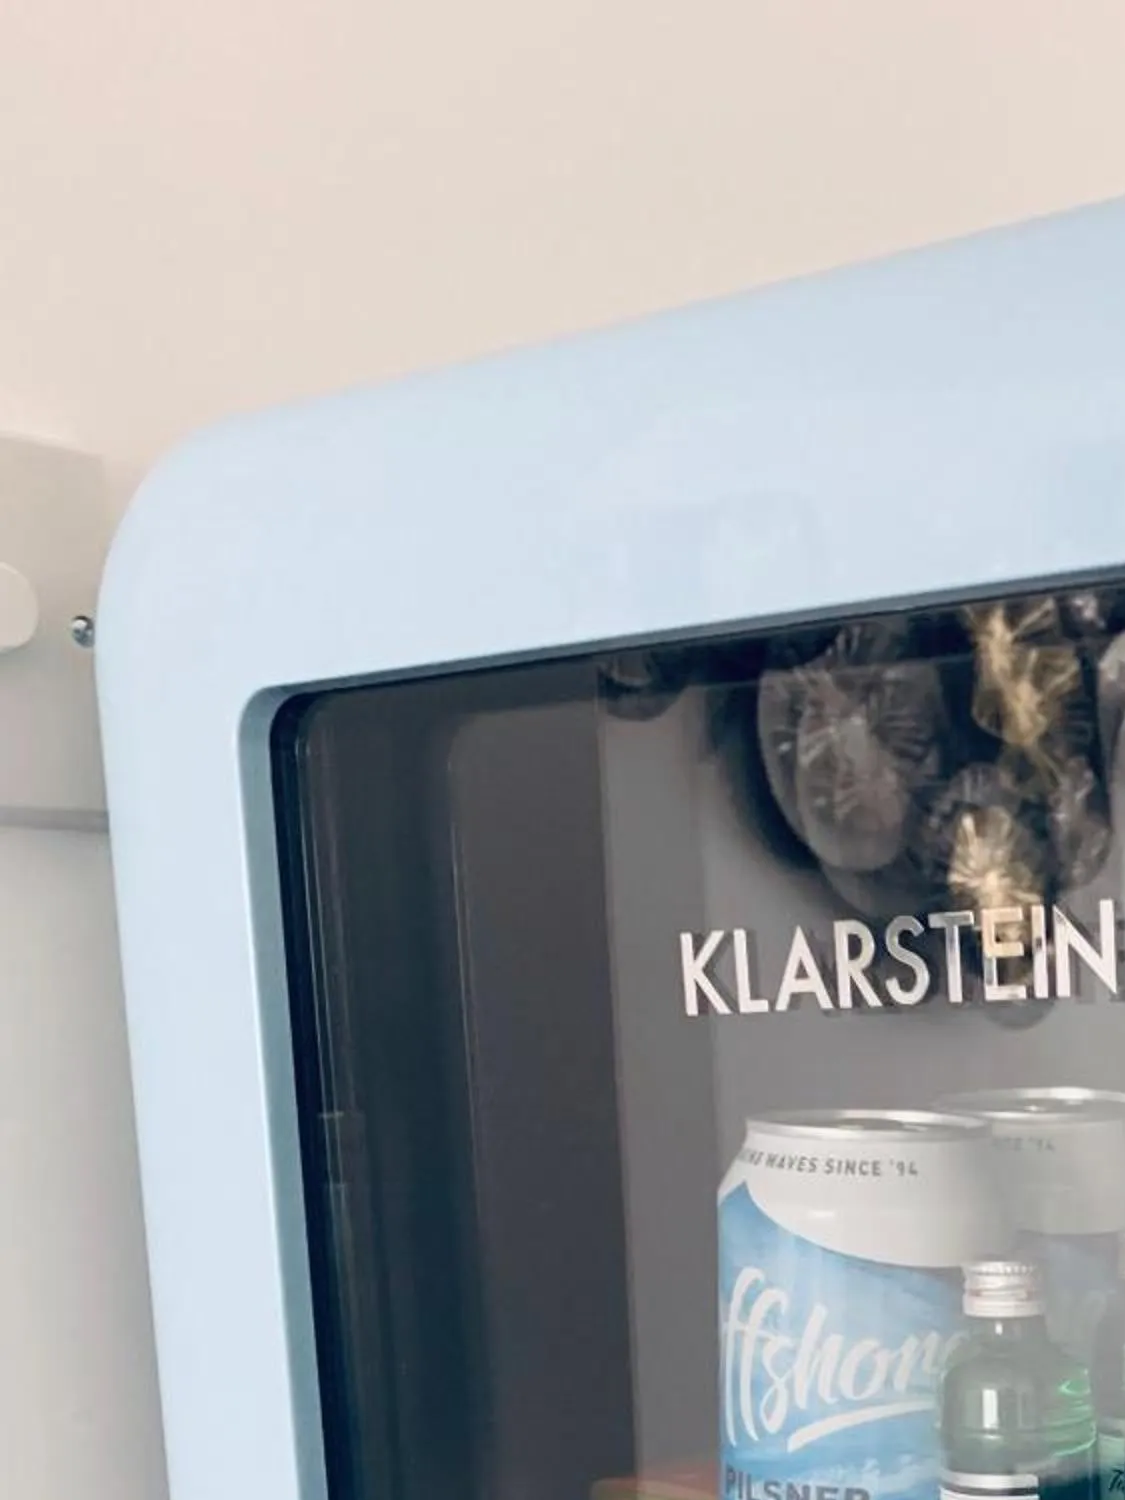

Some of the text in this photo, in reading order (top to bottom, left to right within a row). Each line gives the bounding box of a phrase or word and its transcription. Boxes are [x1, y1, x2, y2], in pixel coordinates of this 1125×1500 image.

[679, 899, 1118, 1017] KLARSTEIN
[765, 1152, 817, 1173] WAVES
[823, 1157, 882, 1177] SINCE
[722, 1266, 970, 1447] ffshor
